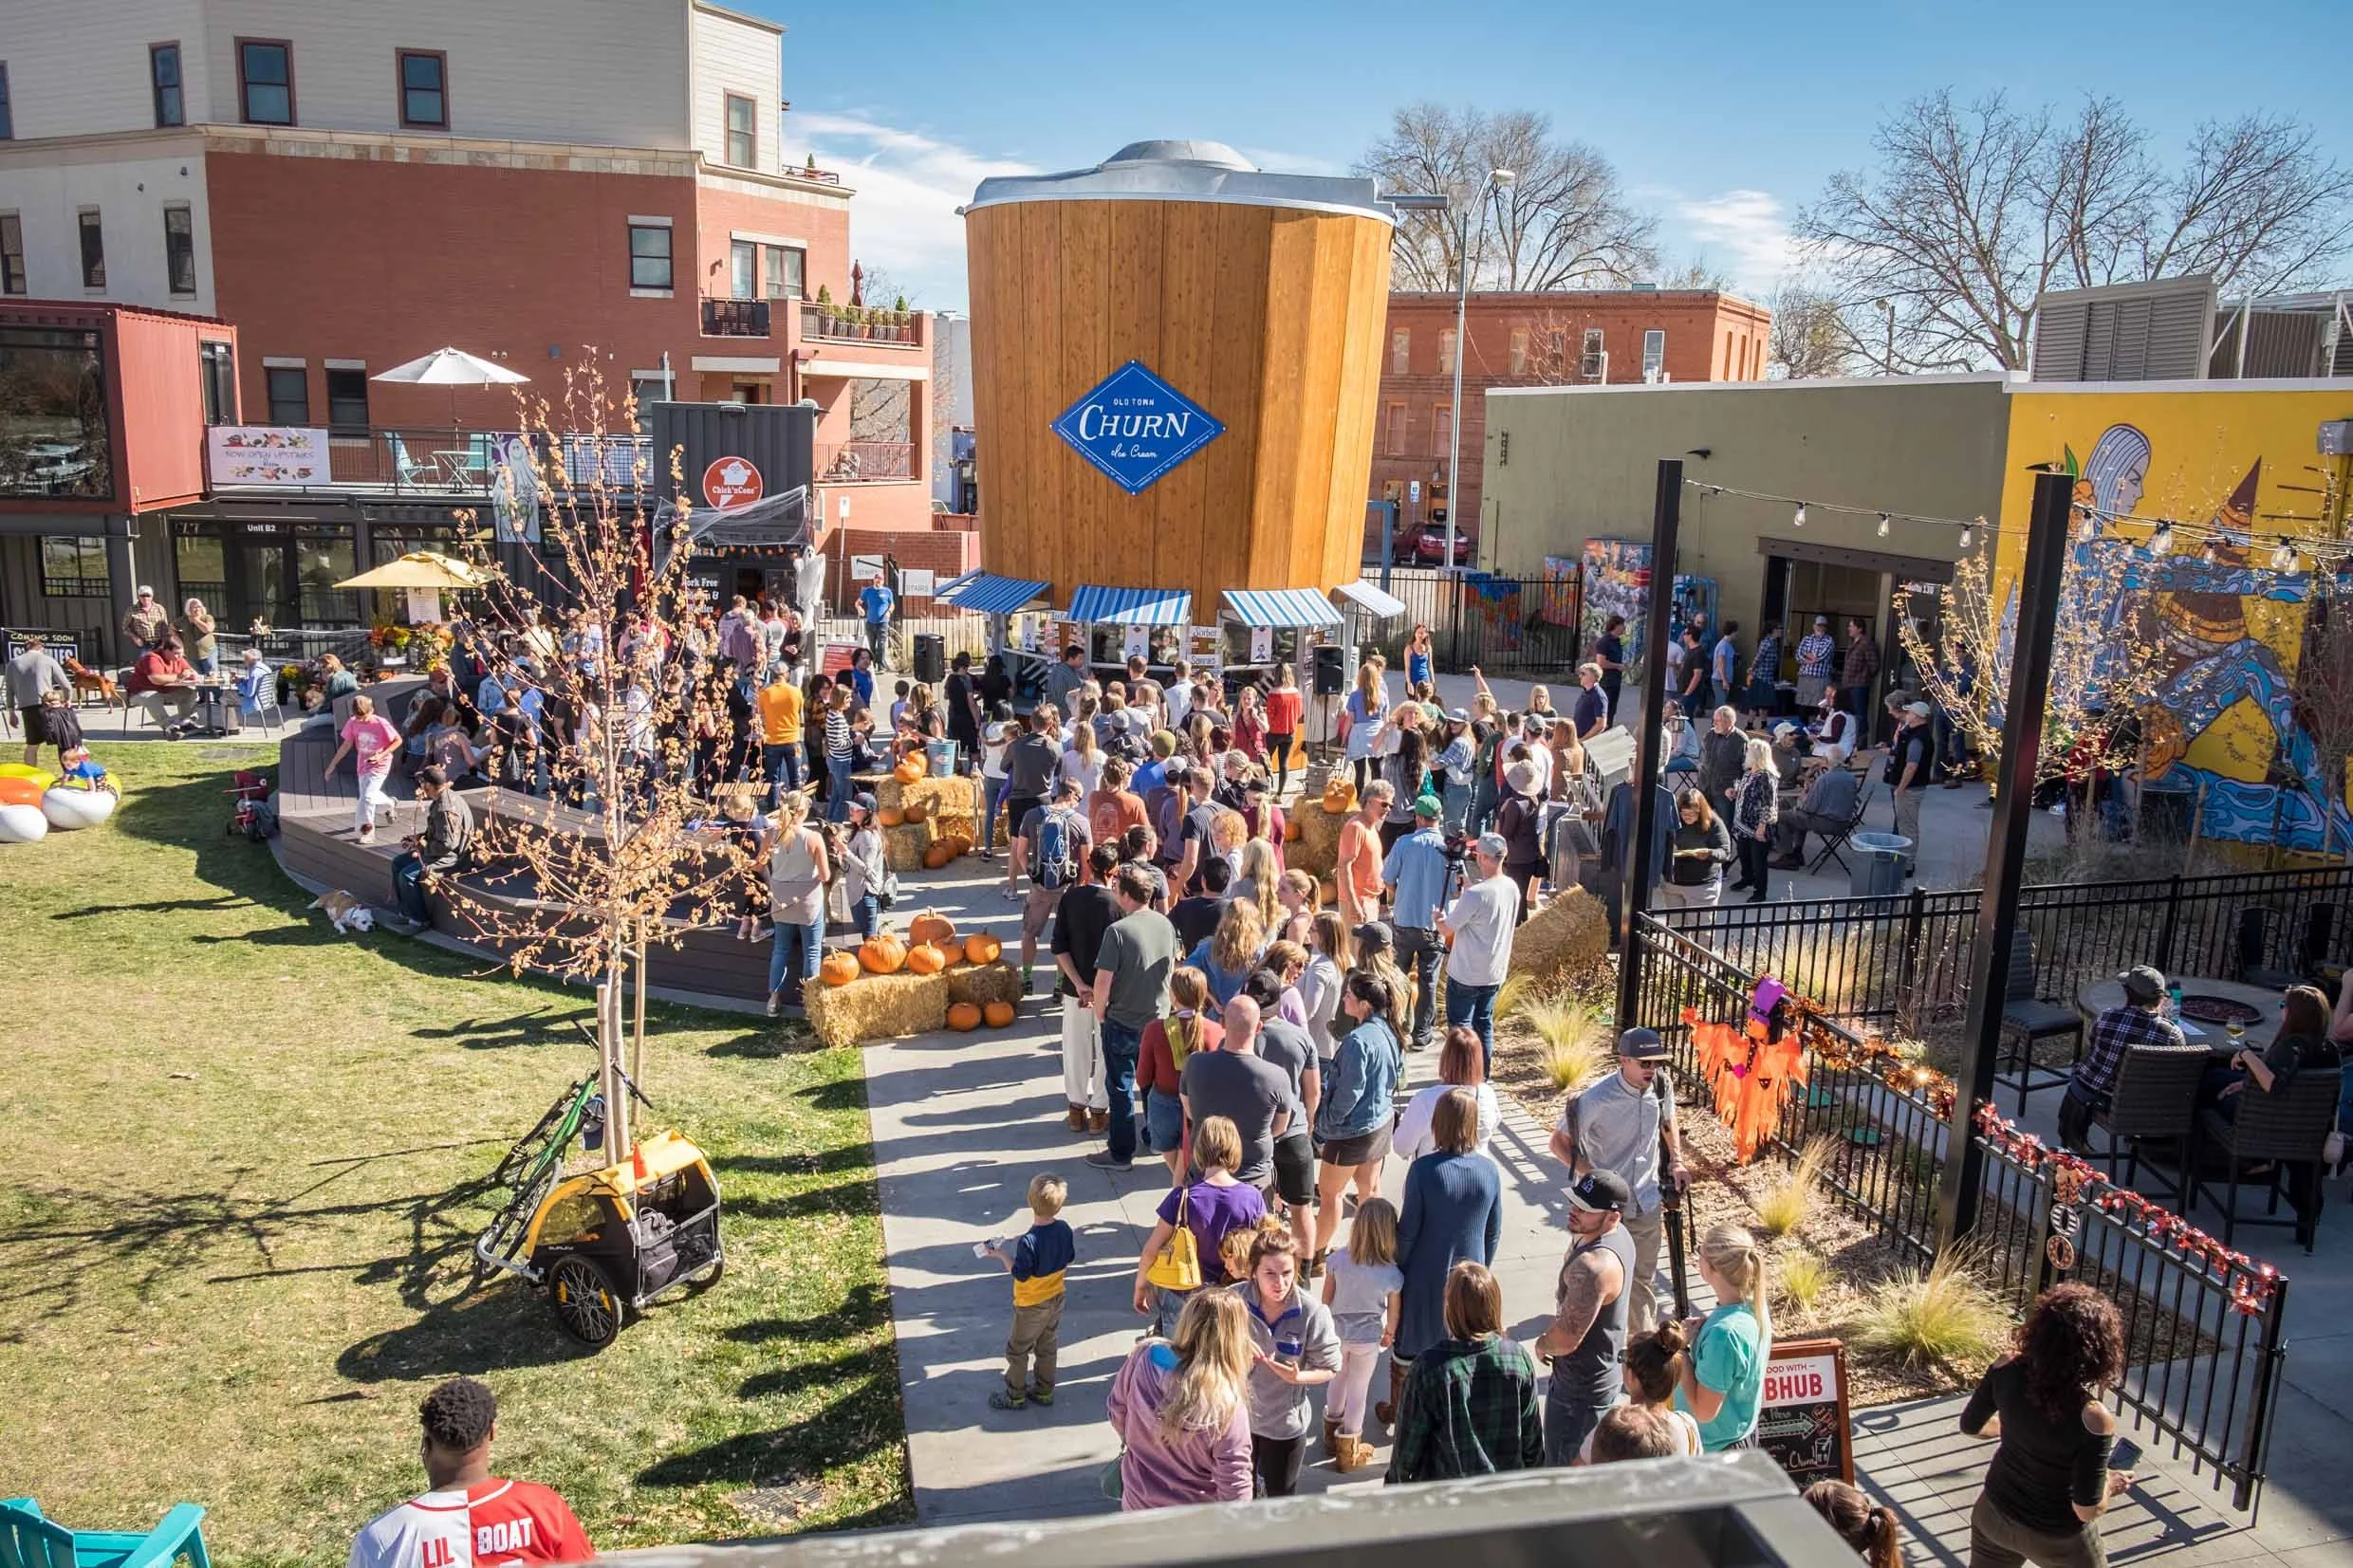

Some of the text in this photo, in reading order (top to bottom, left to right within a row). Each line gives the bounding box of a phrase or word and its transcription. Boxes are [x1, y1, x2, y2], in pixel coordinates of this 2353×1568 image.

[1079, 404, 1192, 441] CHURN
[249, 451, 271, 459] OPEN
[1111, 443, 1158, 458] Ice Cream
[247, 524, 277, 532] Unit B2
[701, 577, 718, 588] Free
[1766, 1363, 1807, 1374] OOD WITH
[1765, 1373, 1824, 1401] BHUB
[422, 1517, 533, 1568] LIL BOAT
